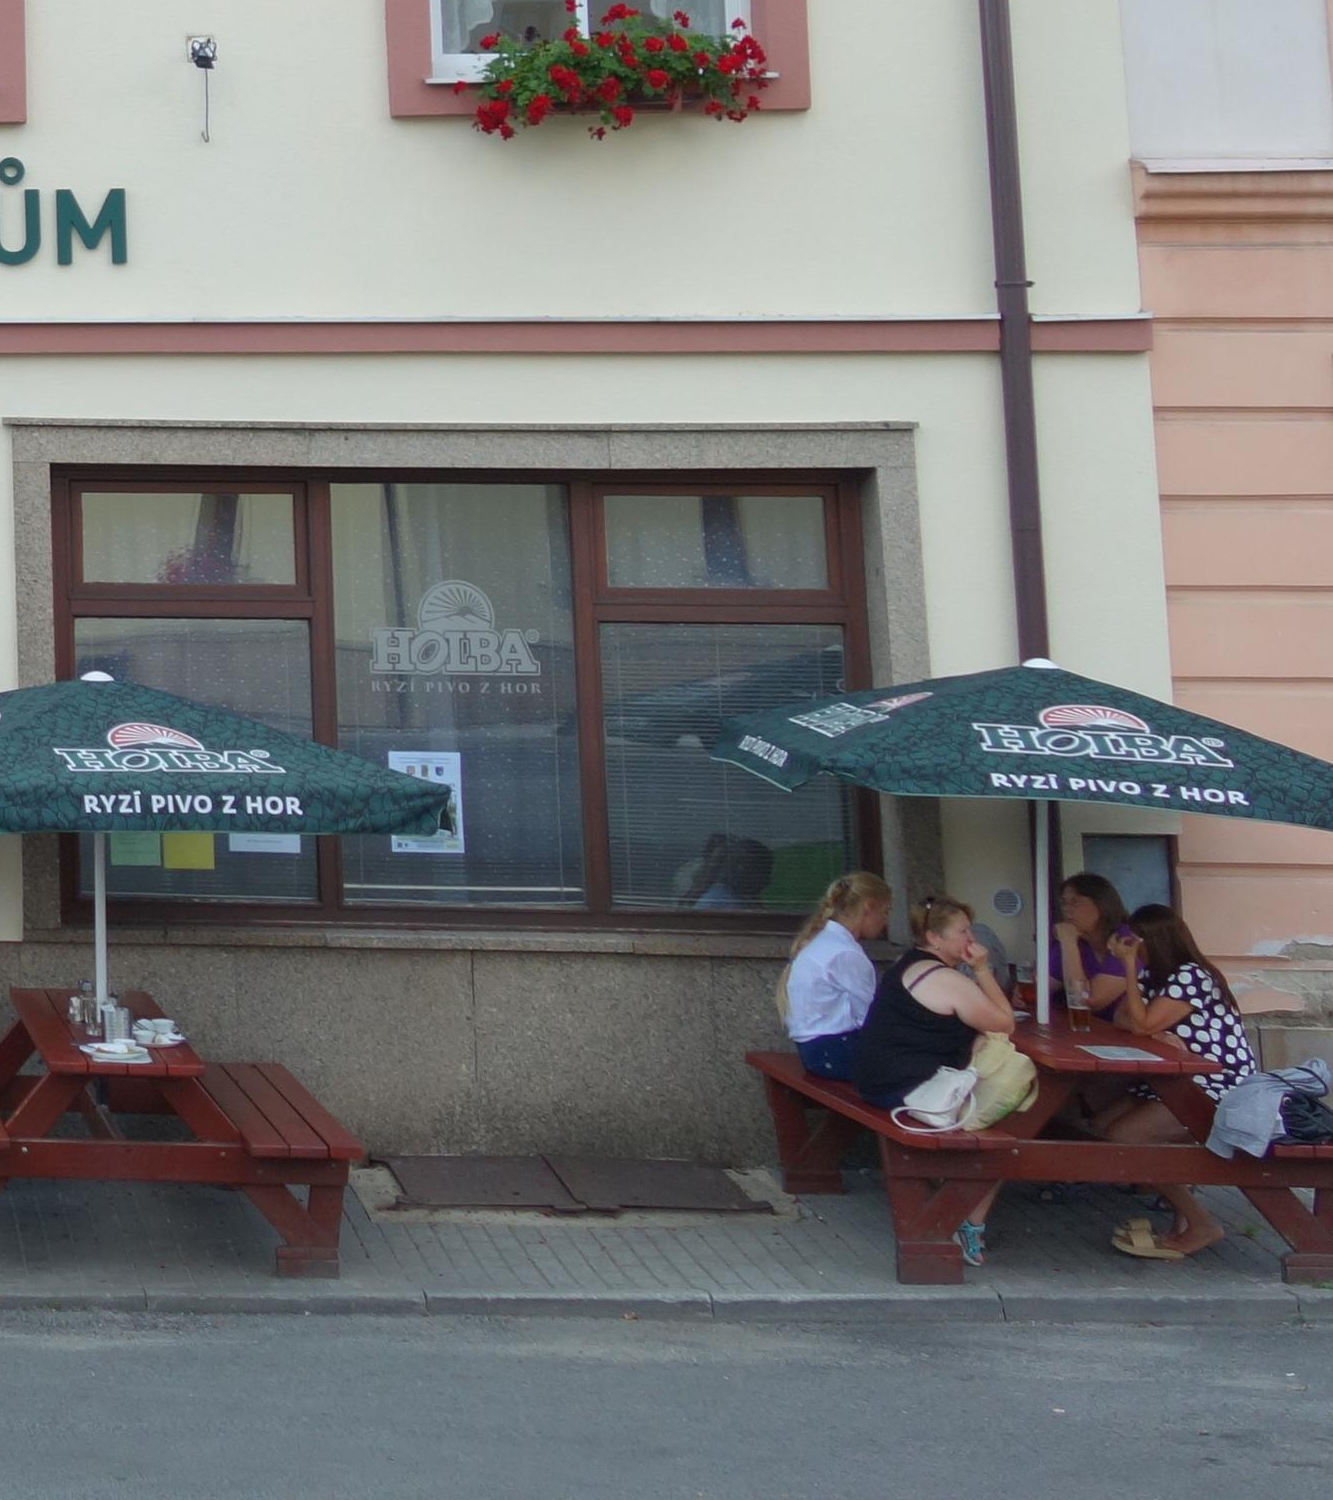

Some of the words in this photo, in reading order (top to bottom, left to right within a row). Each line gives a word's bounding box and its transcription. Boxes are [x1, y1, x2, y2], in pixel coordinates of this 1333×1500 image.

[369, 627, 541, 676] HOLBA
[371, 679, 415, 693] RYZÍ
[425, 681, 471, 693] PIVO
[480, 682, 491, 693] Z
[500, 681, 542, 694] HOR
[972, 723, 1234, 768] HOLBA
[53, 748, 287, 774] HOLBA
[83, 791, 142, 814] RYZÍ
[151, 795, 213, 814] PIVO
[221, 795, 237, 815] Z
[246, 796, 303, 816] HOR
[990, 772, 1060, 790] RYZÍ
[1068, 777, 1141, 796] PIVO
[1151, 783, 1171, 799] Z
[1179, 786, 1250, 806] HOR
